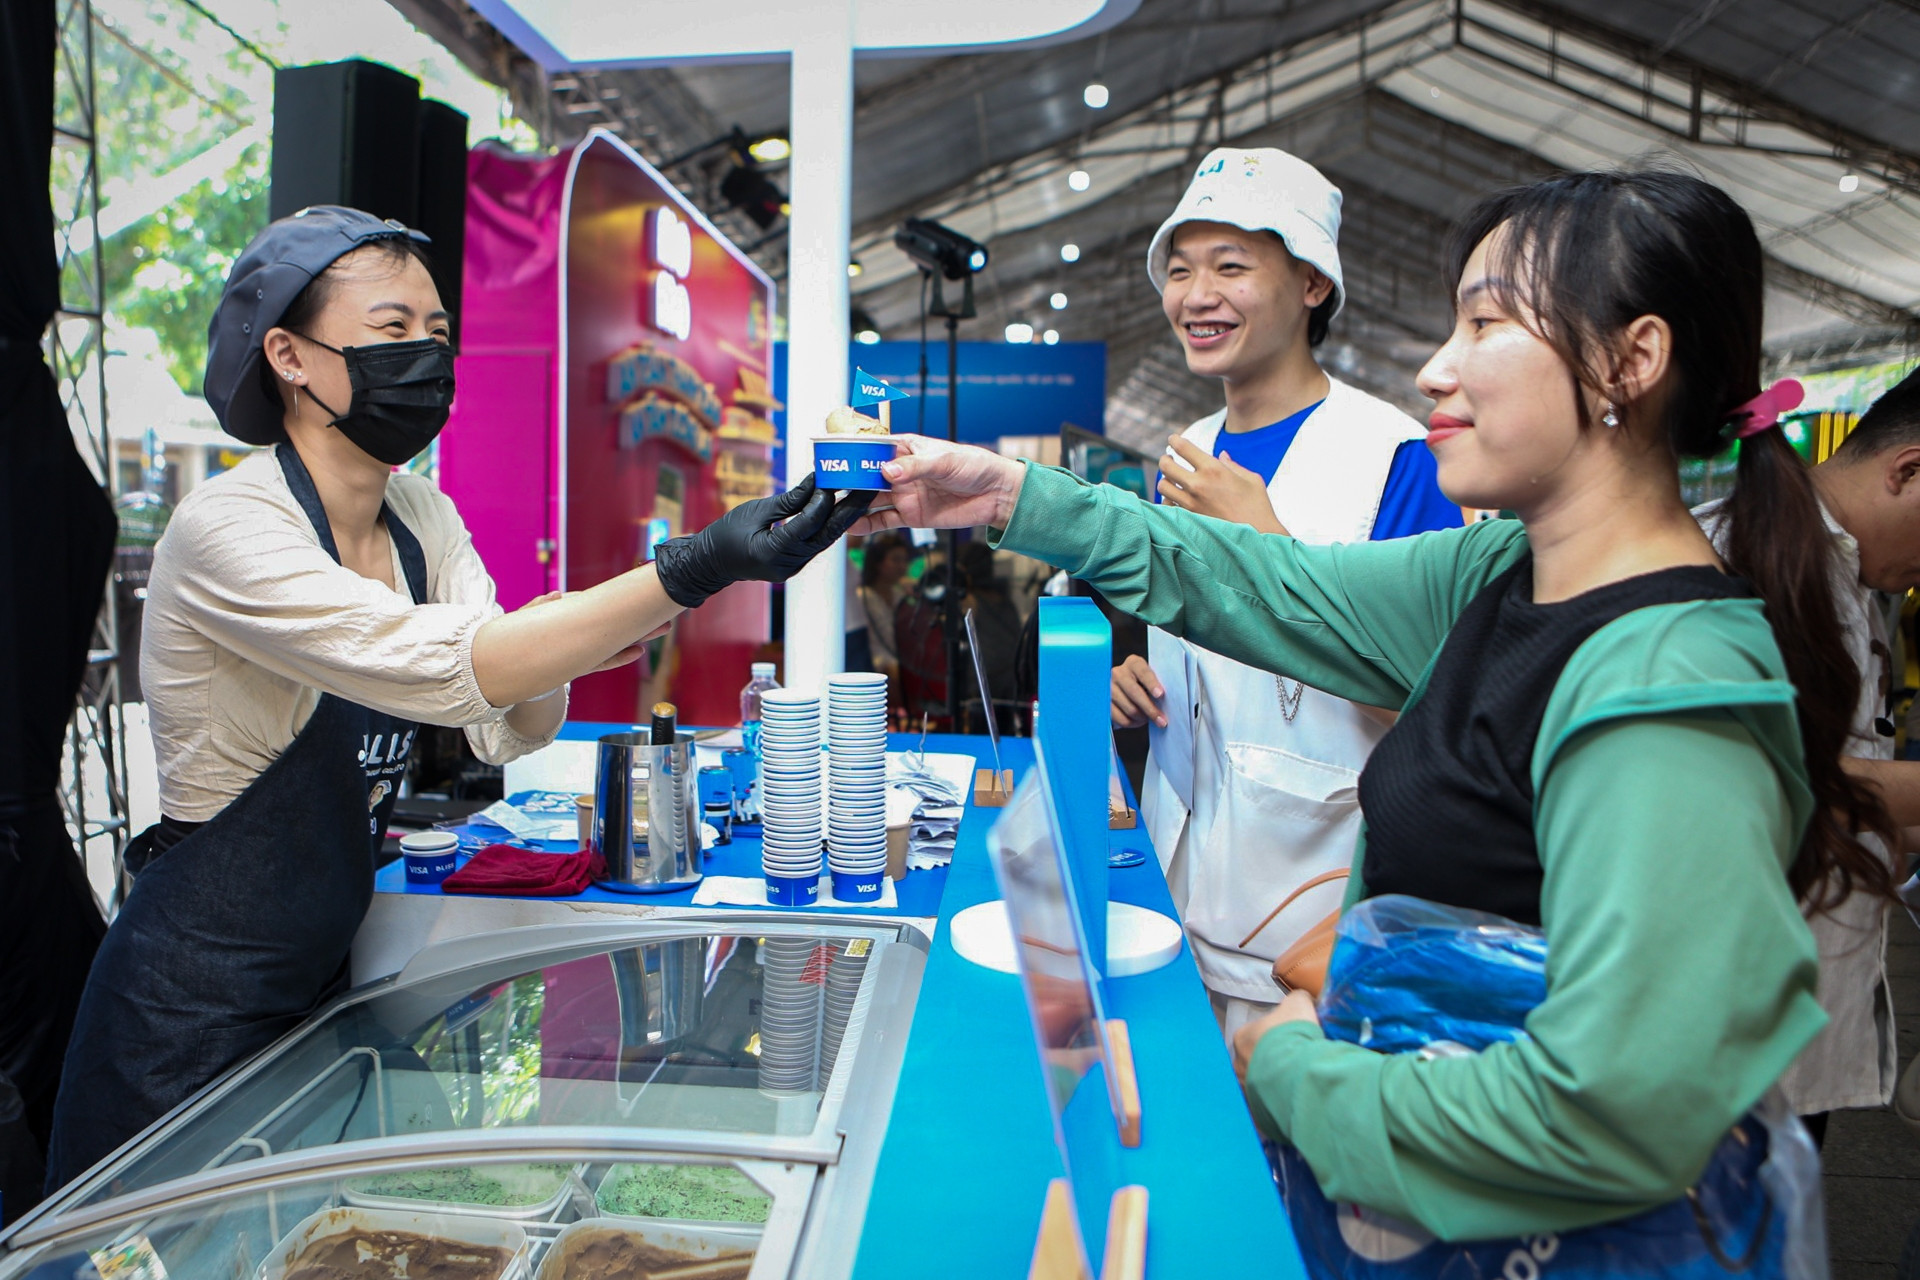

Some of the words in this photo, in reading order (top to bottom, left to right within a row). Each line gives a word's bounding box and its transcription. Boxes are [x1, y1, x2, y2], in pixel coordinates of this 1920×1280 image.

[861, 384, 886, 397] VISA
[820, 459, 849, 472] VISA
[409, 865, 429, 875] VISA
[435, 862, 454, 872] BLISS
[856, 883, 877, 893] VISA
